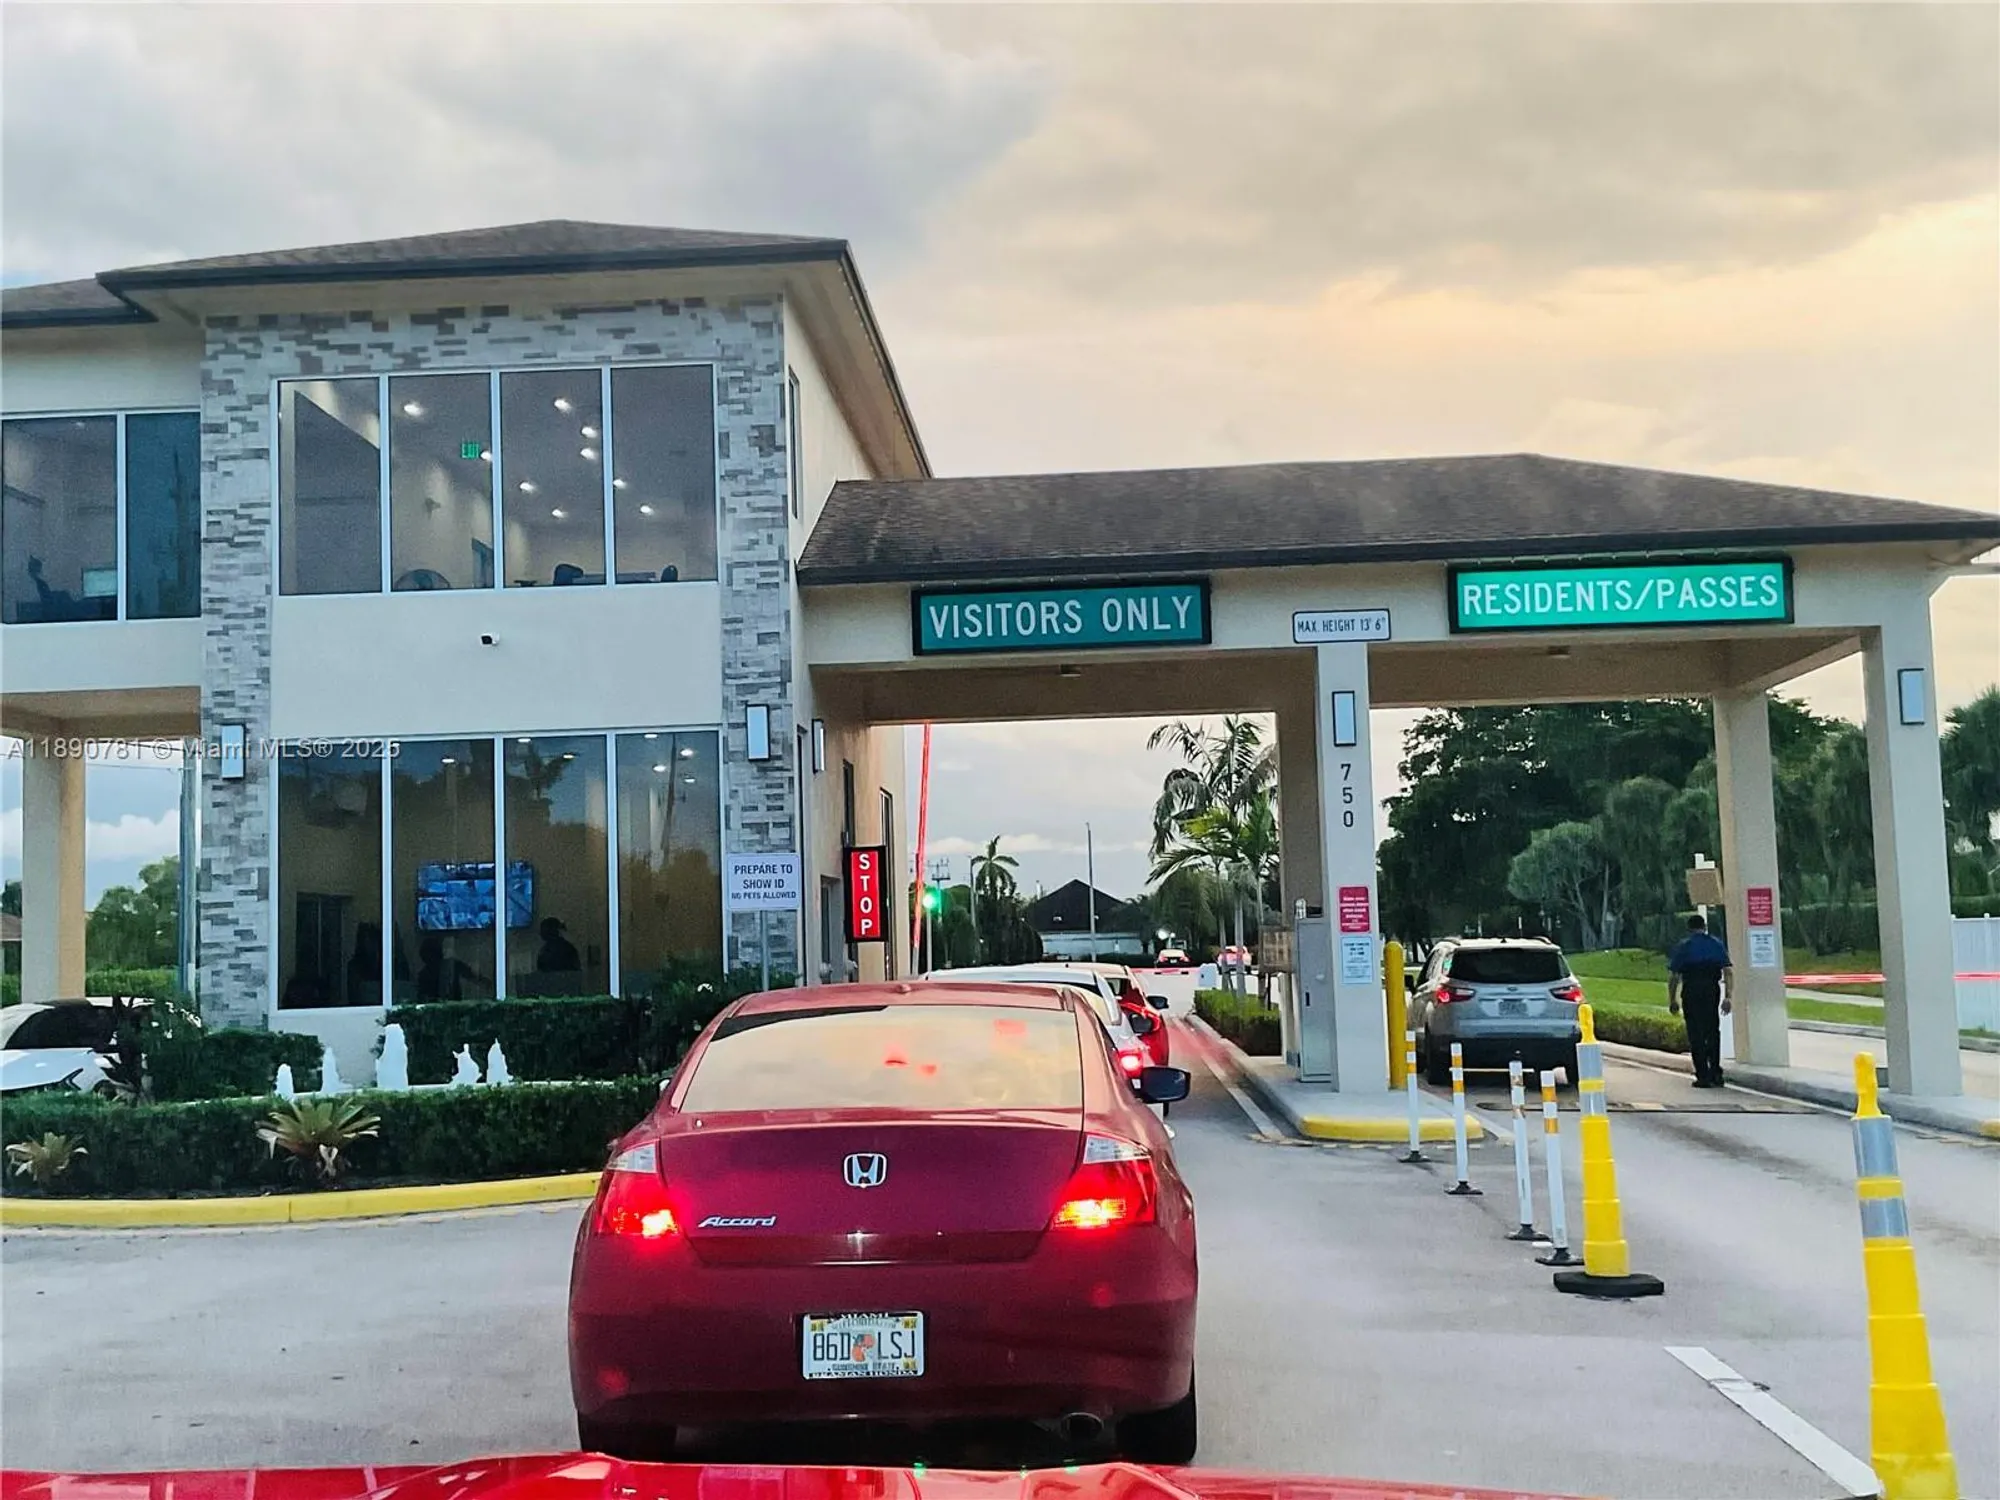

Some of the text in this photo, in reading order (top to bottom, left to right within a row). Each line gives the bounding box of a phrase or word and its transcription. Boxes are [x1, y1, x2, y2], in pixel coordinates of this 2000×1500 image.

[1463, 575, 1778, 616] RESIDENTS/PASSES
[929, 595, 1192, 639] VISITORS ONLY
[1322, 618, 1356, 632] HEIGHT
[734, 863, 793, 875] PREPARE TO
[742, 878, 785, 889] SHOW ID
[731, 891, 797, 900] NO PETS ALLOWED
[858, 853, 873, 936] STOP
[698, 1216, 777, 1228] Accord
[877, 1331, 915, 1359] LSJ
